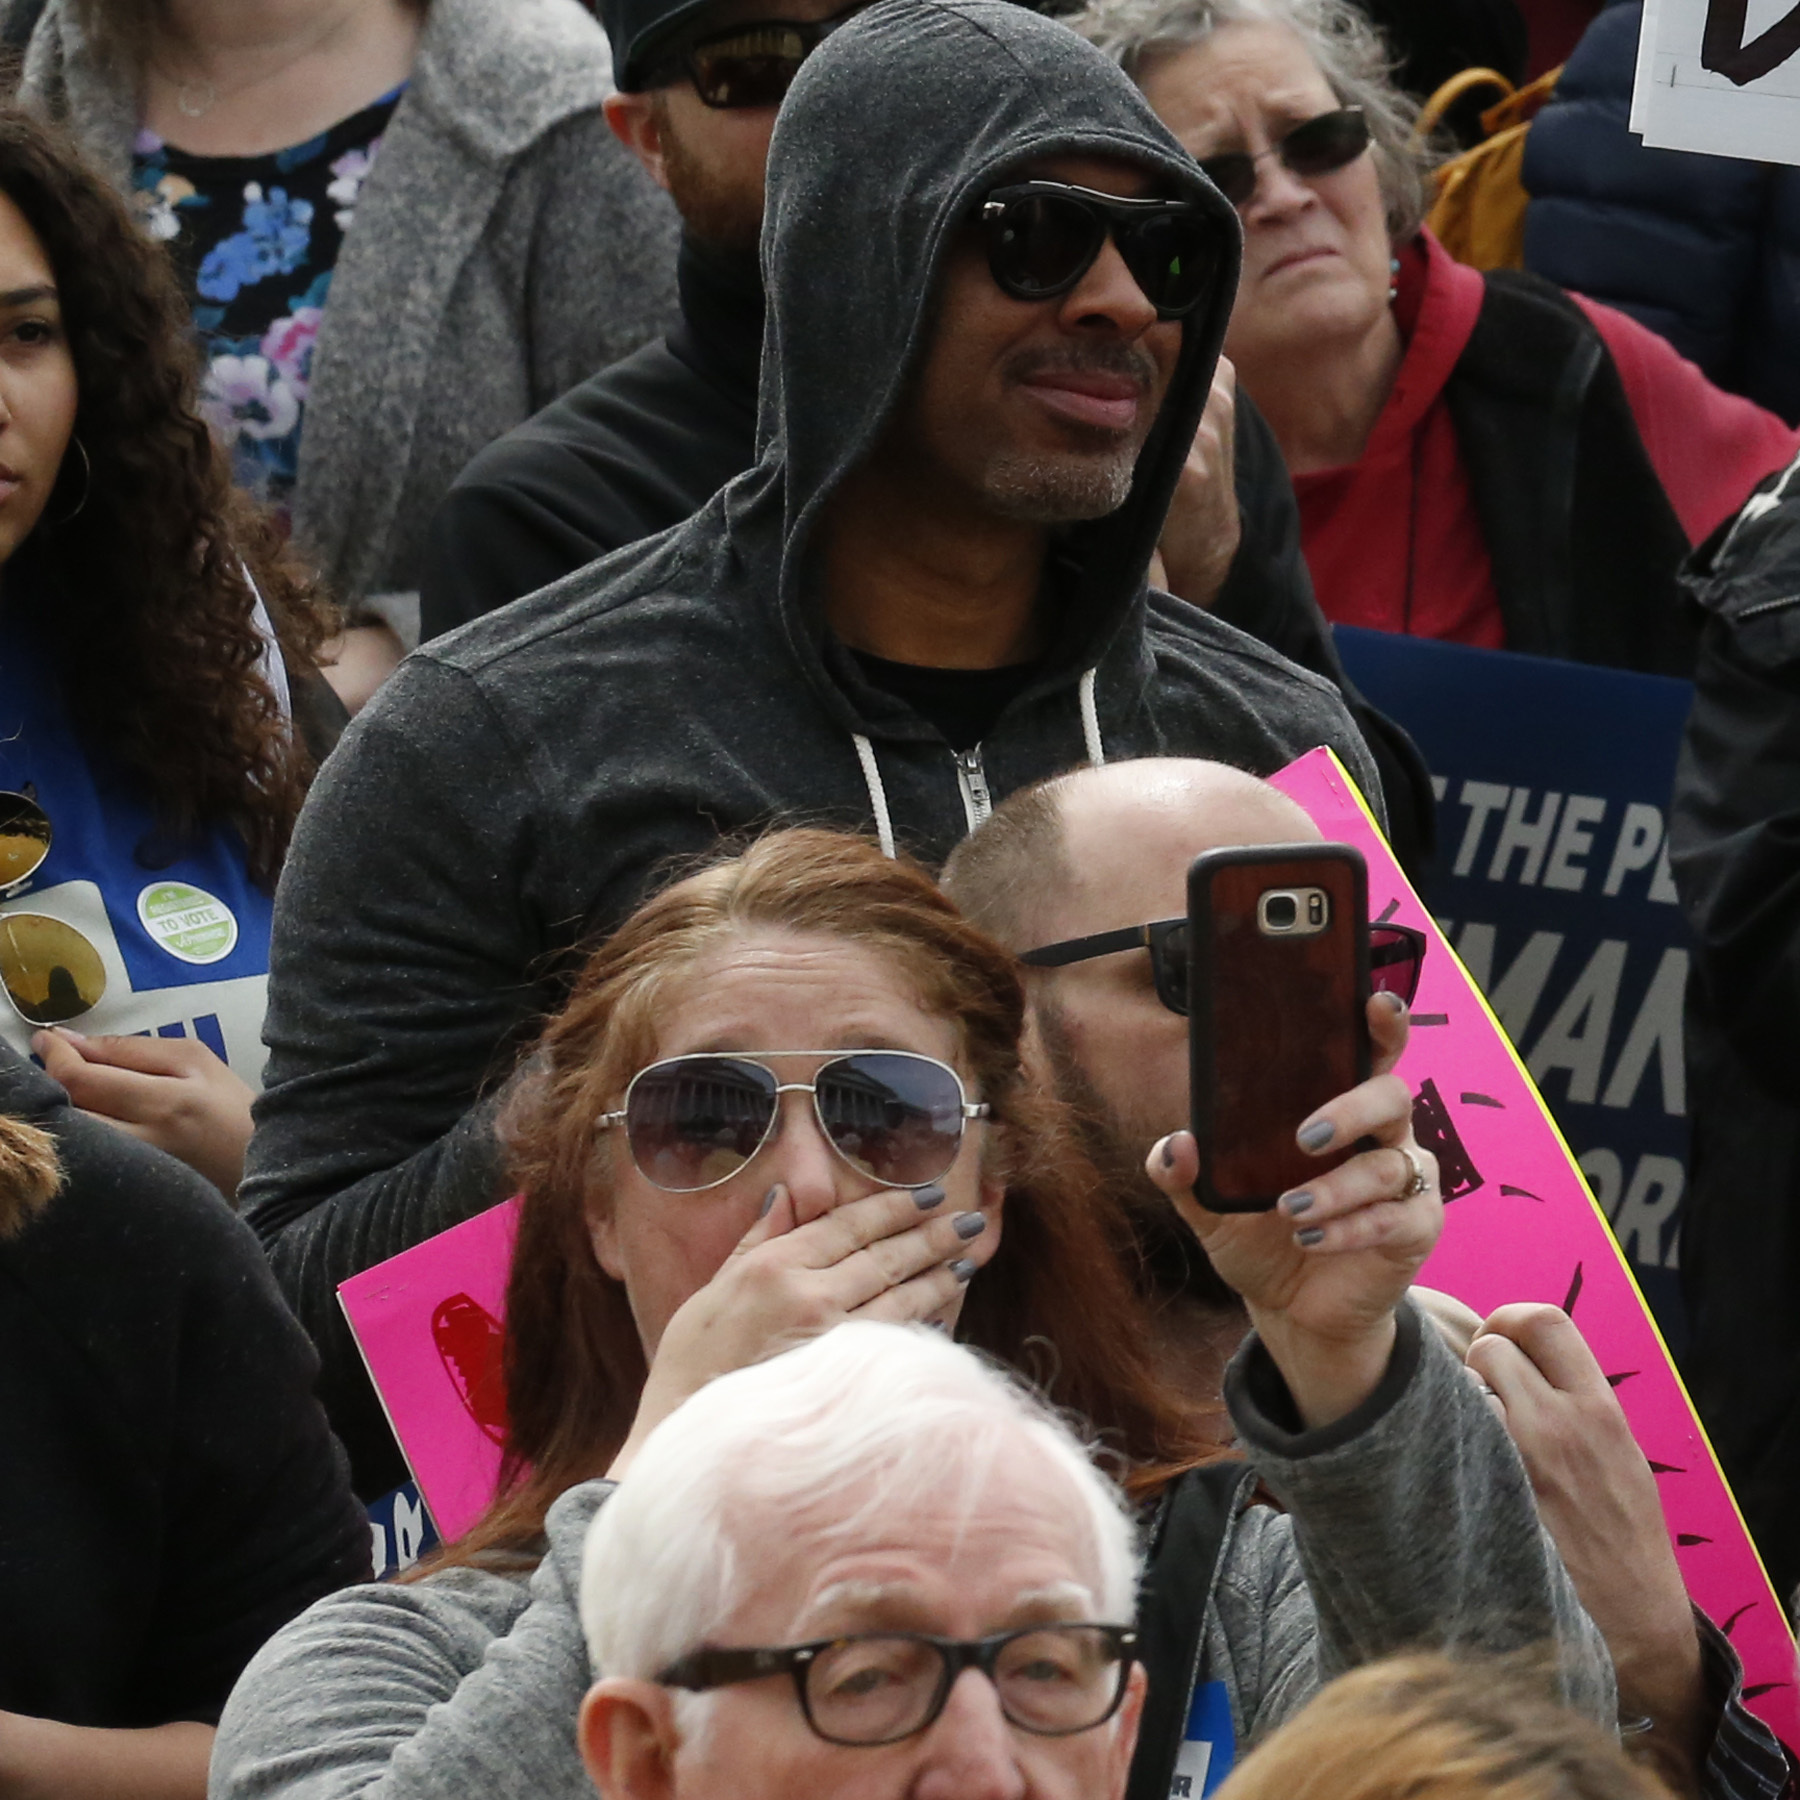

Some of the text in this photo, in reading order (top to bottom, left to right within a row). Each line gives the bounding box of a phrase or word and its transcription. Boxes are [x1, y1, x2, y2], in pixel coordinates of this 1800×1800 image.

[1452, 779, 1606, 893] THE
[156, 908, 219, 933] TO VOTE
